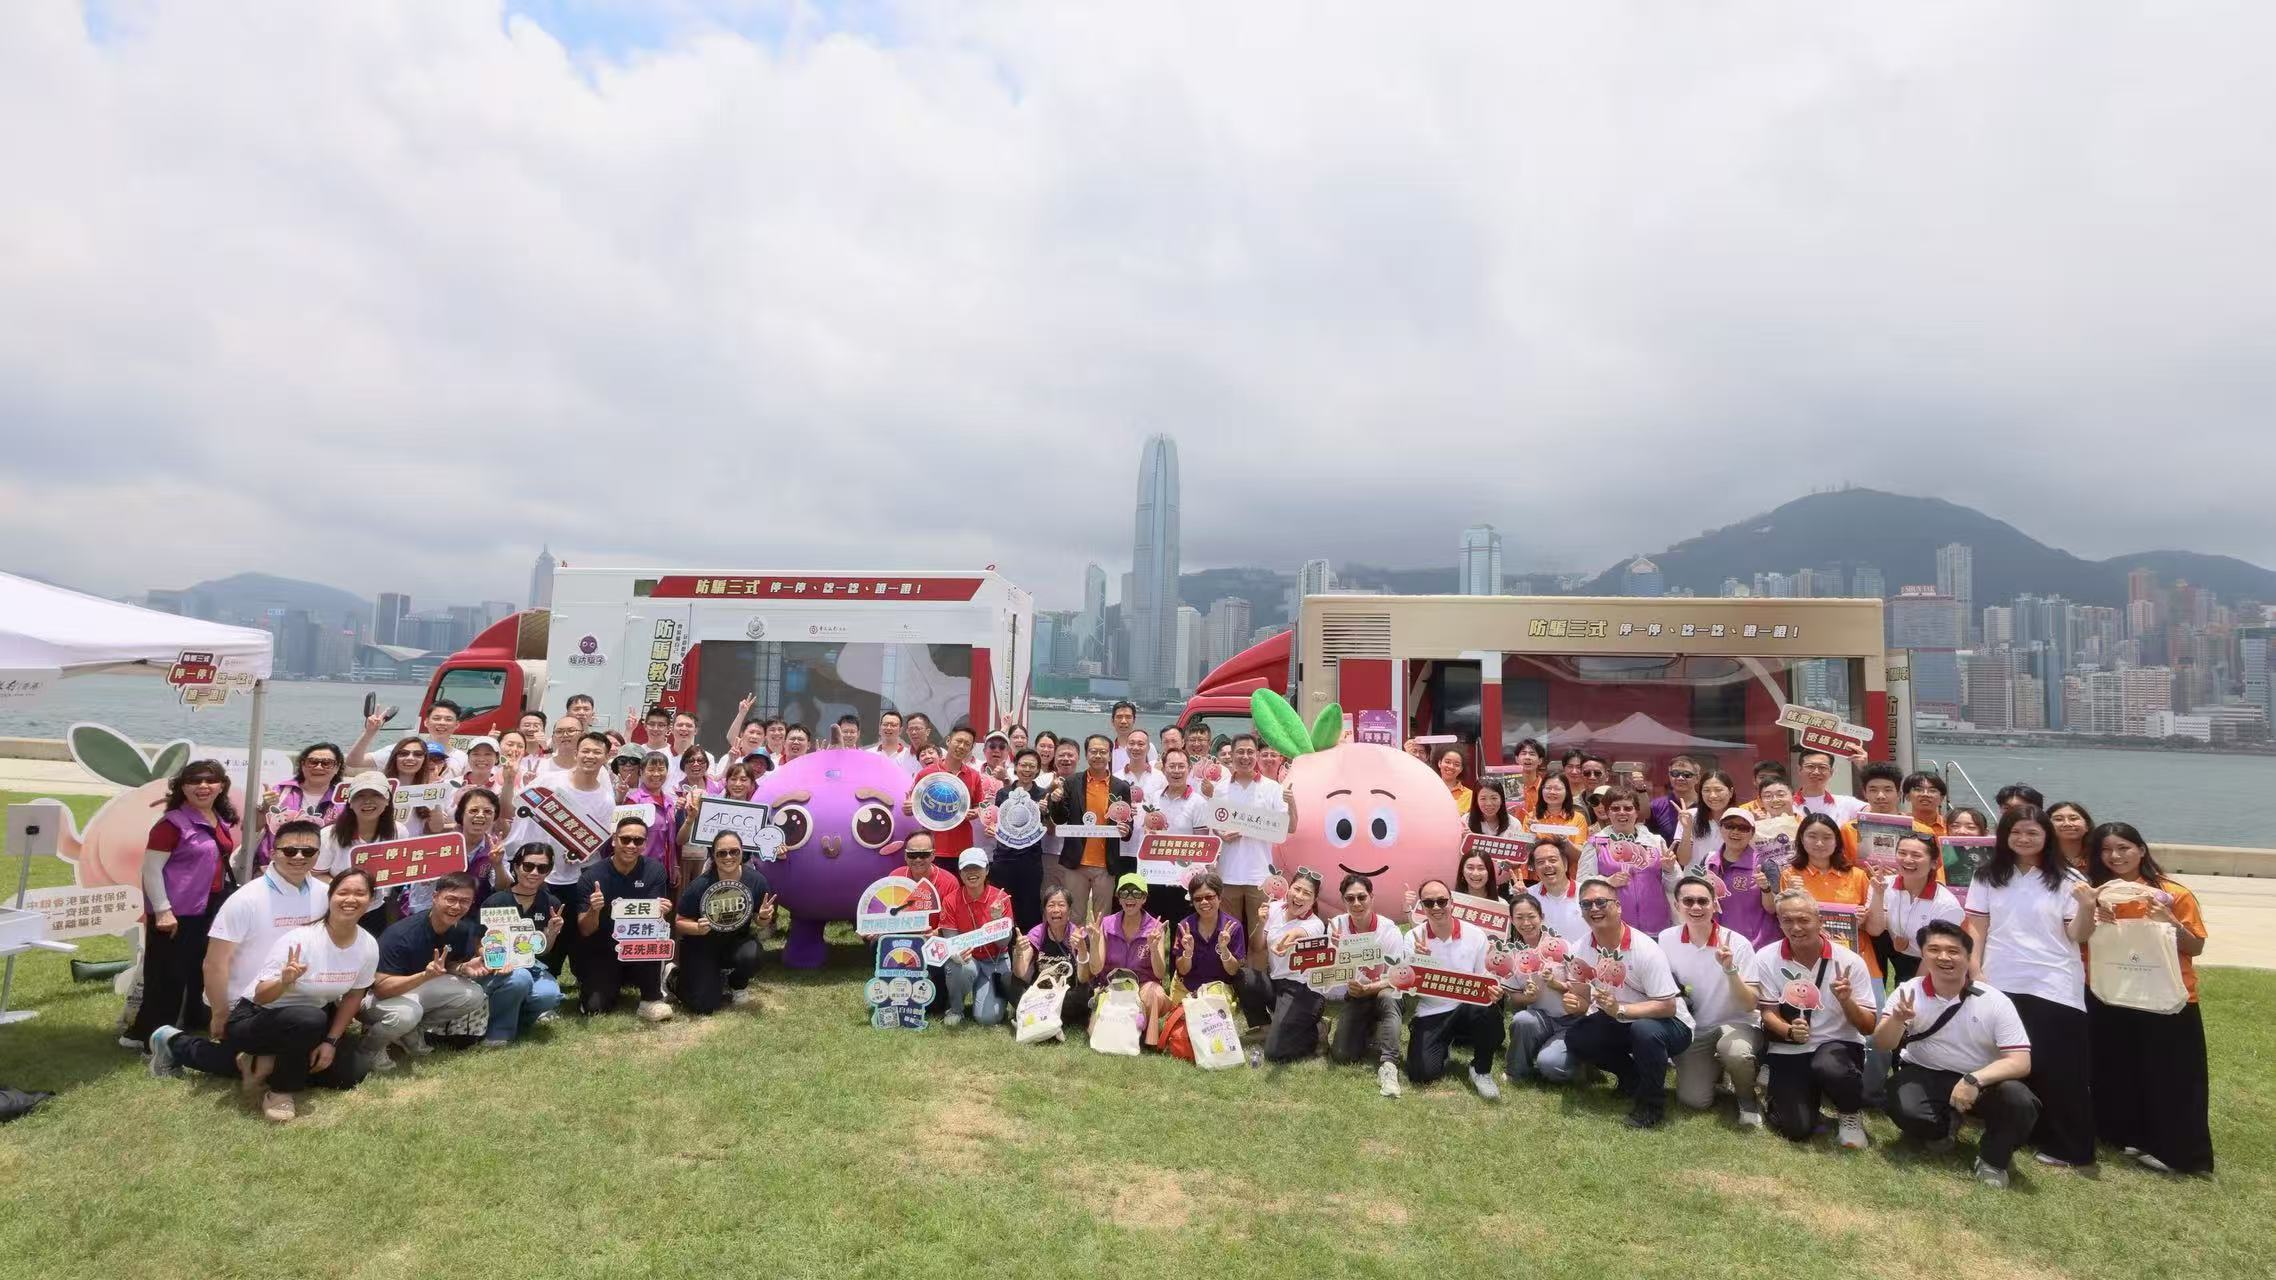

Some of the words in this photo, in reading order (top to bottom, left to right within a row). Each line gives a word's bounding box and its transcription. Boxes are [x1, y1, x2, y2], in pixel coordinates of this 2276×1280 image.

[695, 579, 760, 595] 防騙三式
[1528, 619, 1608, 637] 防騙三式
[705, 812, 754, 828] ADCC
[624, 903, 650, 916] 全民
[627, 923, 654, 936] 反詐
[621, 943, 671, 956] 反洗黑錢
